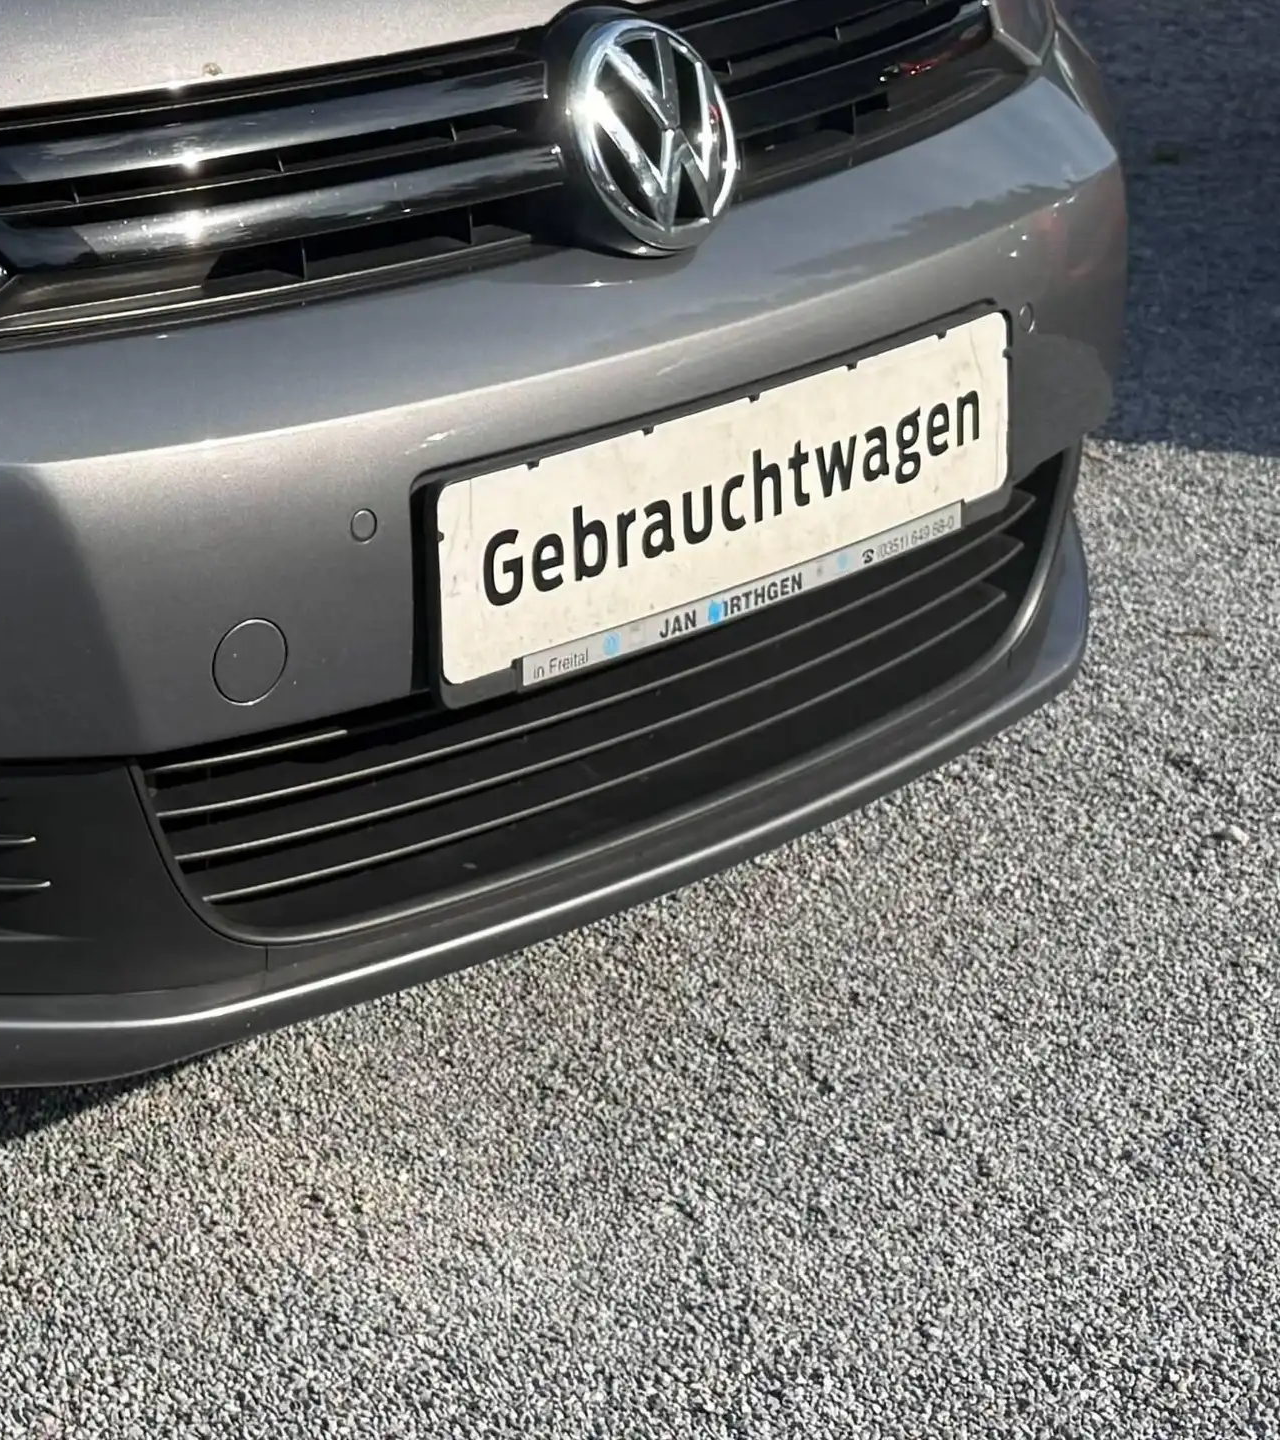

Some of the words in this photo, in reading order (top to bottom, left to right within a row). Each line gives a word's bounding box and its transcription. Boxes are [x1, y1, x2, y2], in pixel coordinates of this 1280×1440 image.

[482, 389, 981, 607] Gebrauchtwagen
[533, 664, 545, 680] in
[549, 649, 589, 673] Freital
[659, 610, 697, 639] JAN
[707, 572, 804, 625] IRTHGEN
